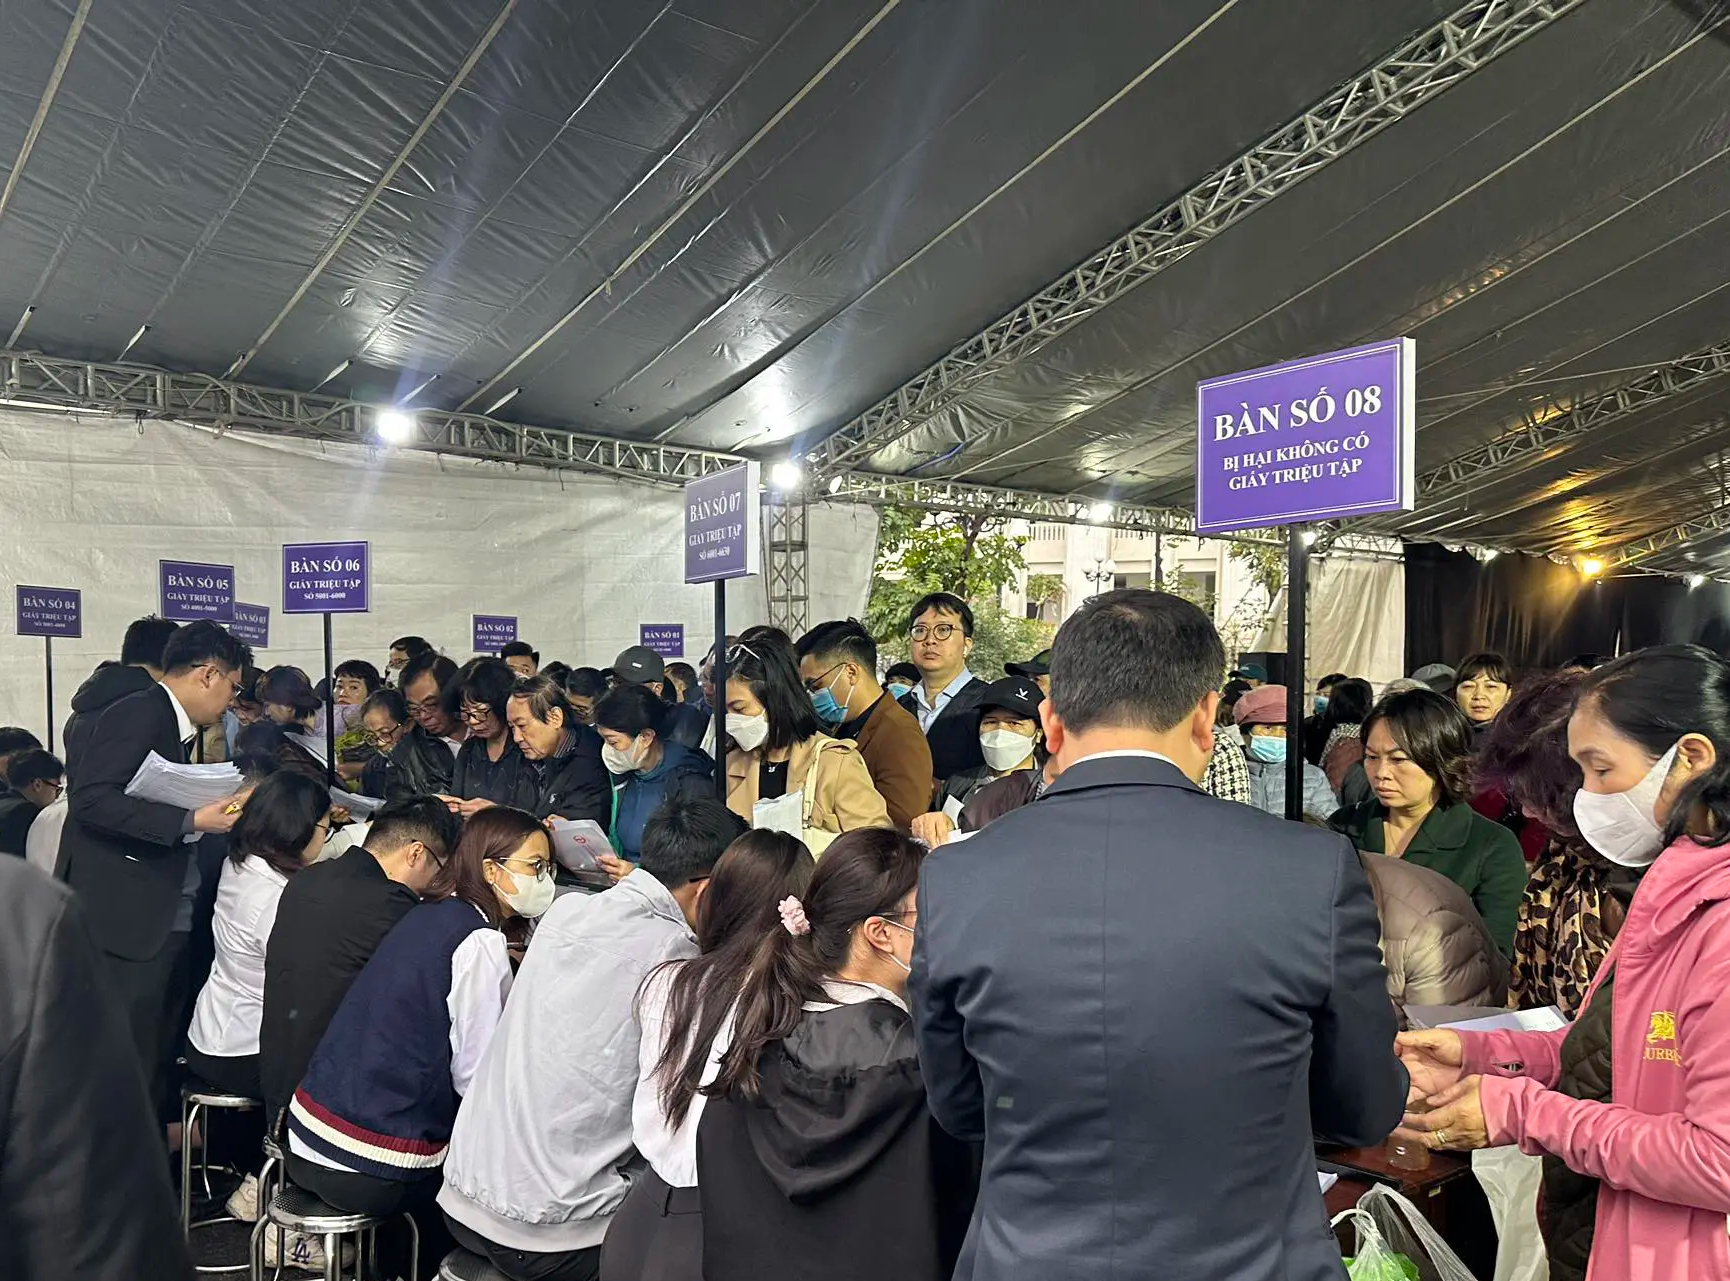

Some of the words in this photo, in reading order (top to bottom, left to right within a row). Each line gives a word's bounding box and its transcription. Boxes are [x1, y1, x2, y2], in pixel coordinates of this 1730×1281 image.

[1213, 403, 1281, 441] BÀN
[1290, 386, 1336, 428] SỐ
[1345, 385, 1382, 417] 08
[1223, 455, 1239, 472] BỊ
[1243, 451, 1272, 469] HẠI
[1276, 440, 1339, 462] KHÔNG
[1342, 431, 1370, 451] CÓ
[1228, 471, 1270, 490] GIẤY
[1272, 465, 1324, 483] TRIỆU
[1327, 458, 1363, 478] TẬP
[690, 497, 711, 522] BÀN
[713, 490, 727, 516] SỐ
[729, 491, 741, 512] 07
[706, 527, 726, 543] TRIỆU
[728, 523, 741, 540] TẬP
[290, 557, 319, 573] BÀN
[323, 556, 342, 572] SỐ
[345, 559, 360, 571] 06
[168, 573, 194, 587] BÀN
[197, 576, 213, 589] SỐ
[216, 579, 229, 590] 05
[289, 579, 312, 589] GIẤY
[314, 579, 340, 590] TRIỆU
[343, 578, 361, 590] TẬP
[23, 596, 46, 607] BÀN
[48, 597, 63, 609] SỐ
[65, 600, 76, 610] 04
[505, 625, 514, 633] 02
